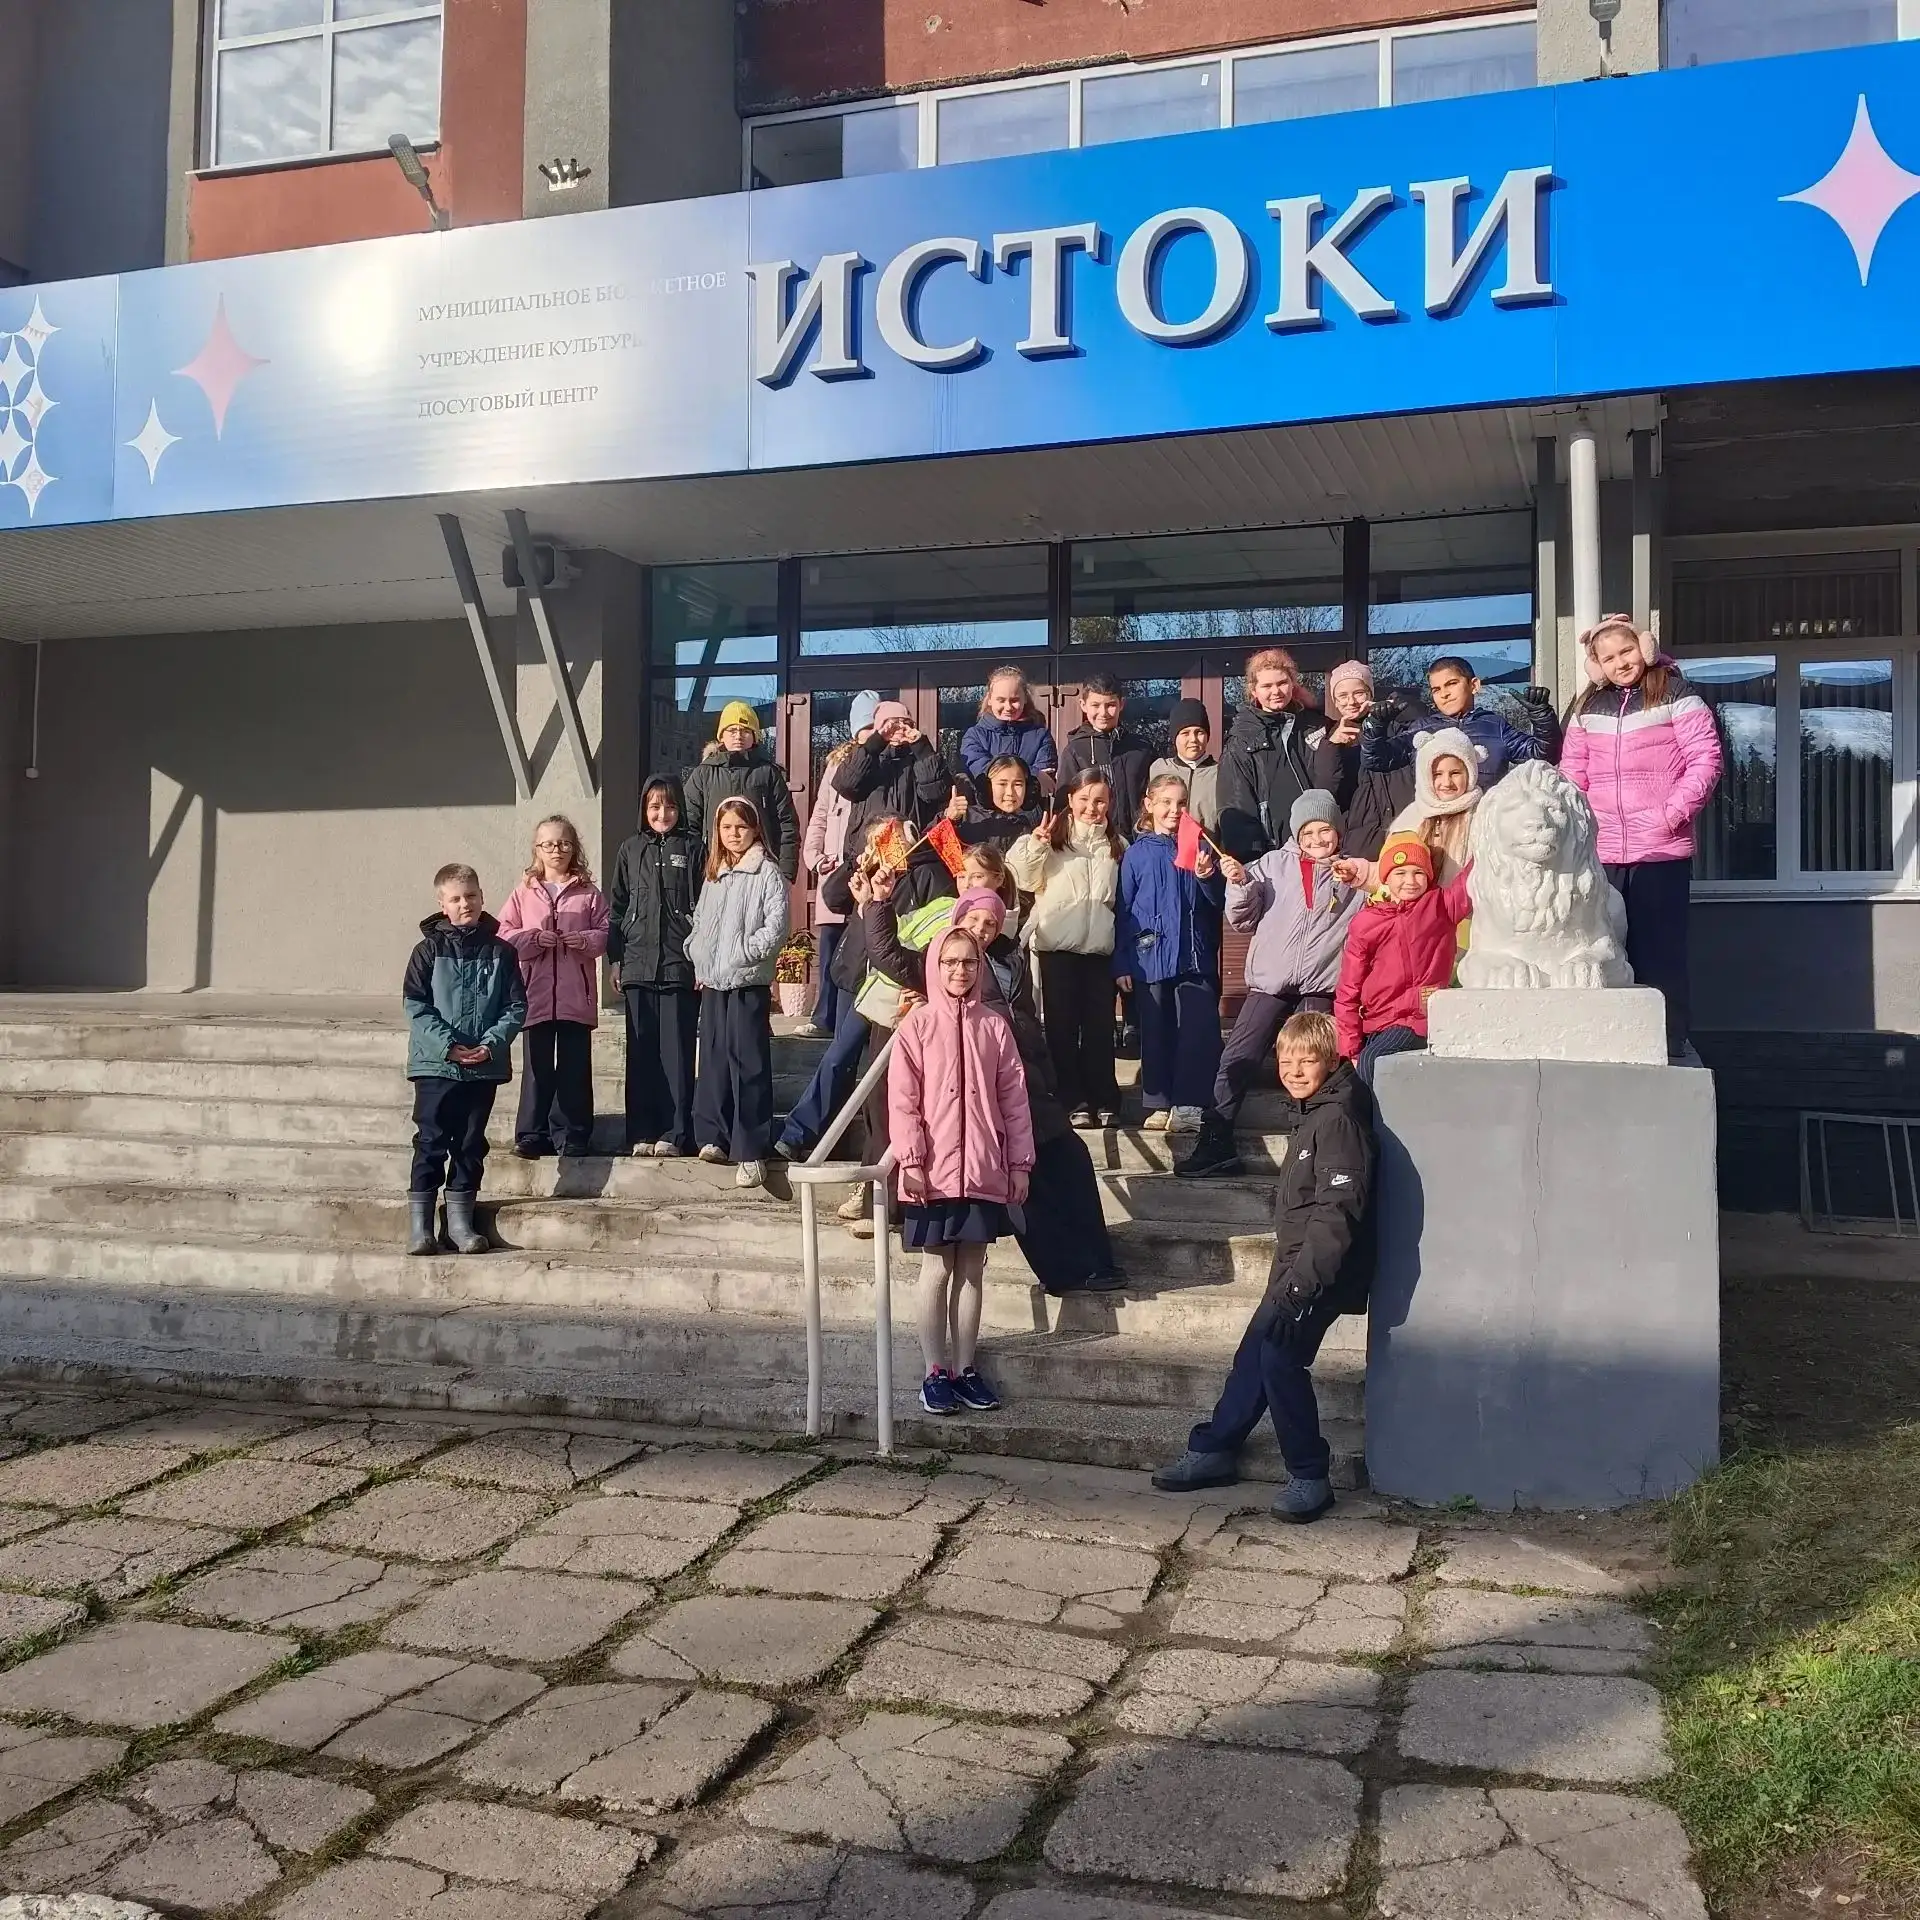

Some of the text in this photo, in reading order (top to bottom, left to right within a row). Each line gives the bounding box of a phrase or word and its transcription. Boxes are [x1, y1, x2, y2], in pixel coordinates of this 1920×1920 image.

[745, 164, 1555, 386] ИСТОКИ
[418, 271, 727, 322] МУНИЦИПАЛЬНОЕ БЮЕТНОЕ
[418, 342, 544, 369] УЧРЕЖДЕНИЕ
[418, 386, 599, 418] ДОСУГОВЫЙ ЦЕНТР
